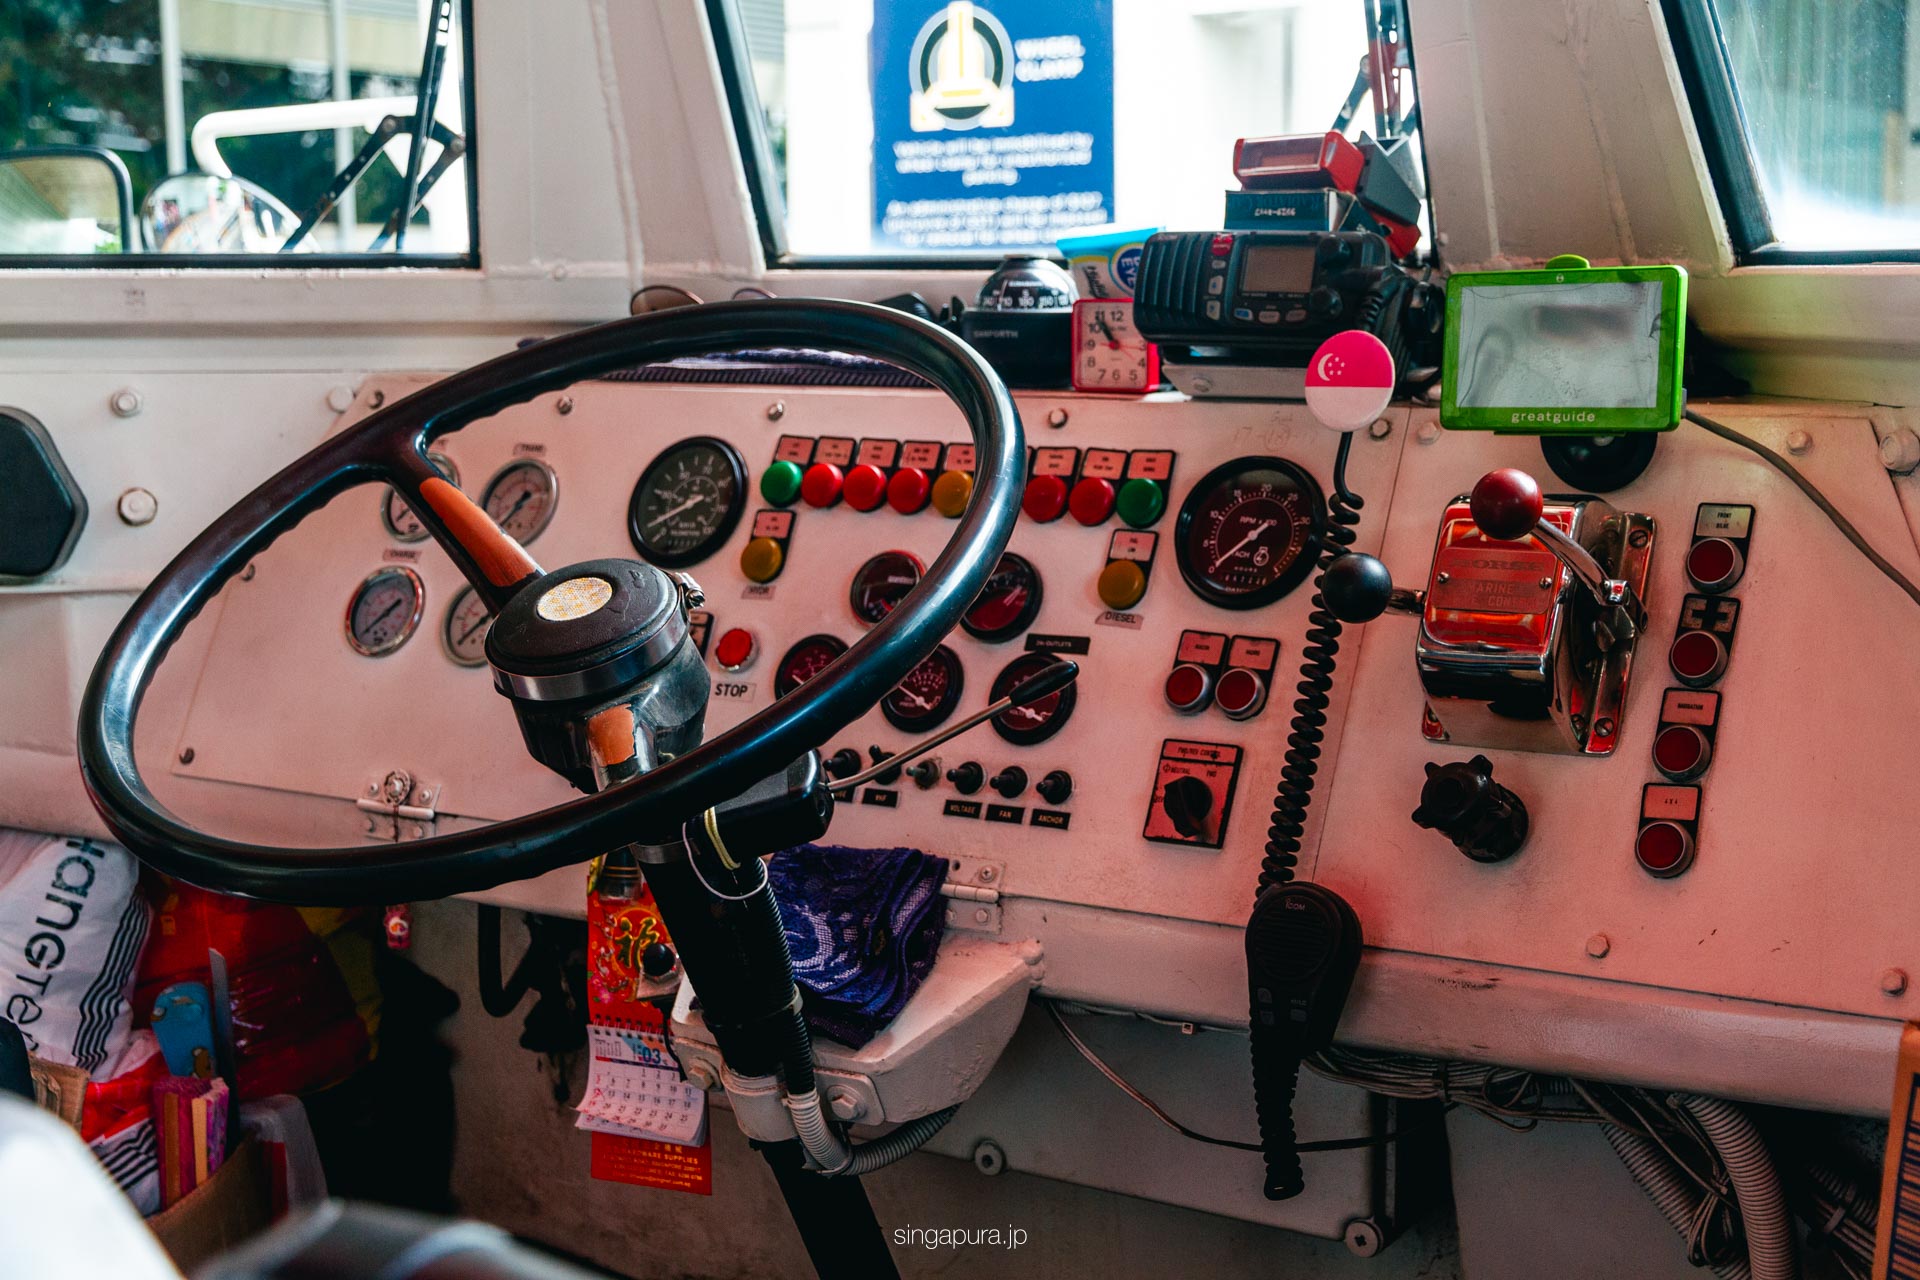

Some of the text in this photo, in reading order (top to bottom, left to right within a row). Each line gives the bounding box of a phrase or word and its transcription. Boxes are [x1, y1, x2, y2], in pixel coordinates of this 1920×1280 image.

[1110, 310, 1124, 322] 12
[1087, 339, 1096, 350] 9
[1087, 356, 1096, 368] 8
[1138, 358, 1146, 368] 4
[1098, 369, 1106, 380] 7
[1112, 369, 1120, 380] 6
[1129, 369, 1138, 380] 5
[1511, 411, 1596, 424] greatguide
[1261, 484, 1272, 493] 20
[1209, 509, 1219, 518] 10
[1240, 516, 1257, 524] RPM
[1104, 611, 1137, 624] DIESEL
[715, 683, 748, 698] STOP
[950, 804, 975, 814] VOLTAGE
[999, 809, 1012, 819] FAN
[1038, 814, 1064, 824] ANCHOR
[642, 1048, 661, 1064] 03
[664, 1153, 699, 1165] SUPPLIES
